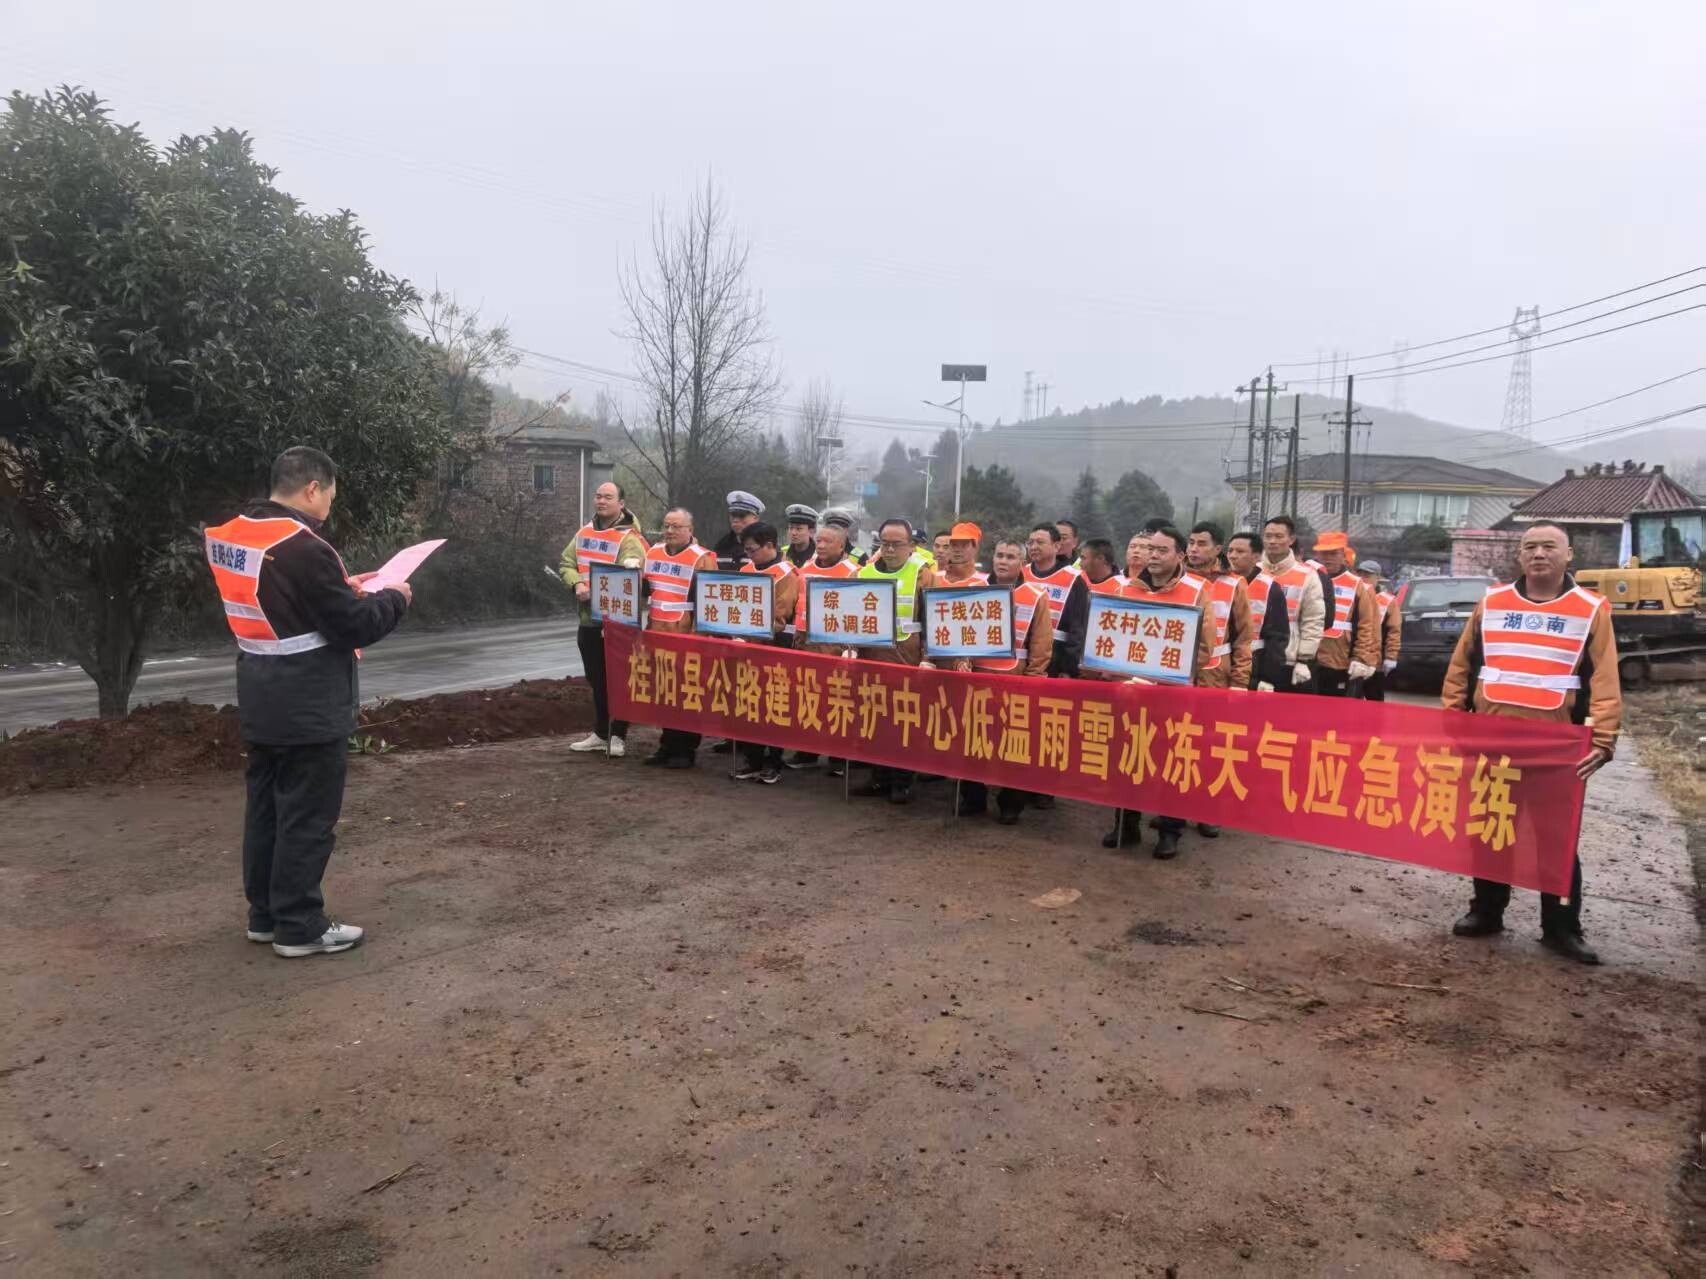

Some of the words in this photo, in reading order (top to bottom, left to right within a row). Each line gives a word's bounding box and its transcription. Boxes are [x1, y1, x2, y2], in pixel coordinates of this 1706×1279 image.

[652, 561, 681, 576] 湖南
[600, 576, 632, 595] 交通
[704, 583, 763, 604] 工程项目
[600, 596, 632, 617] 维护组
[823, 591, 878, 611] 综合
[934, 600, 1003, 621] 干线公路
[704, 604, 764, 627] 抢险组
[823, 614, 878, 634] 协调组
[1503, 612, 1566, 633] 湖南
[935, 625, 1003, 645] 抢险组
[1099, 610, 1185, 643] 农村公路
[1095, 635, 1181, 670] 抢险组
[628, 644, 1522, 852] 桂阳县公路建设养护中心低温雨雪冰冻天气应急演练
